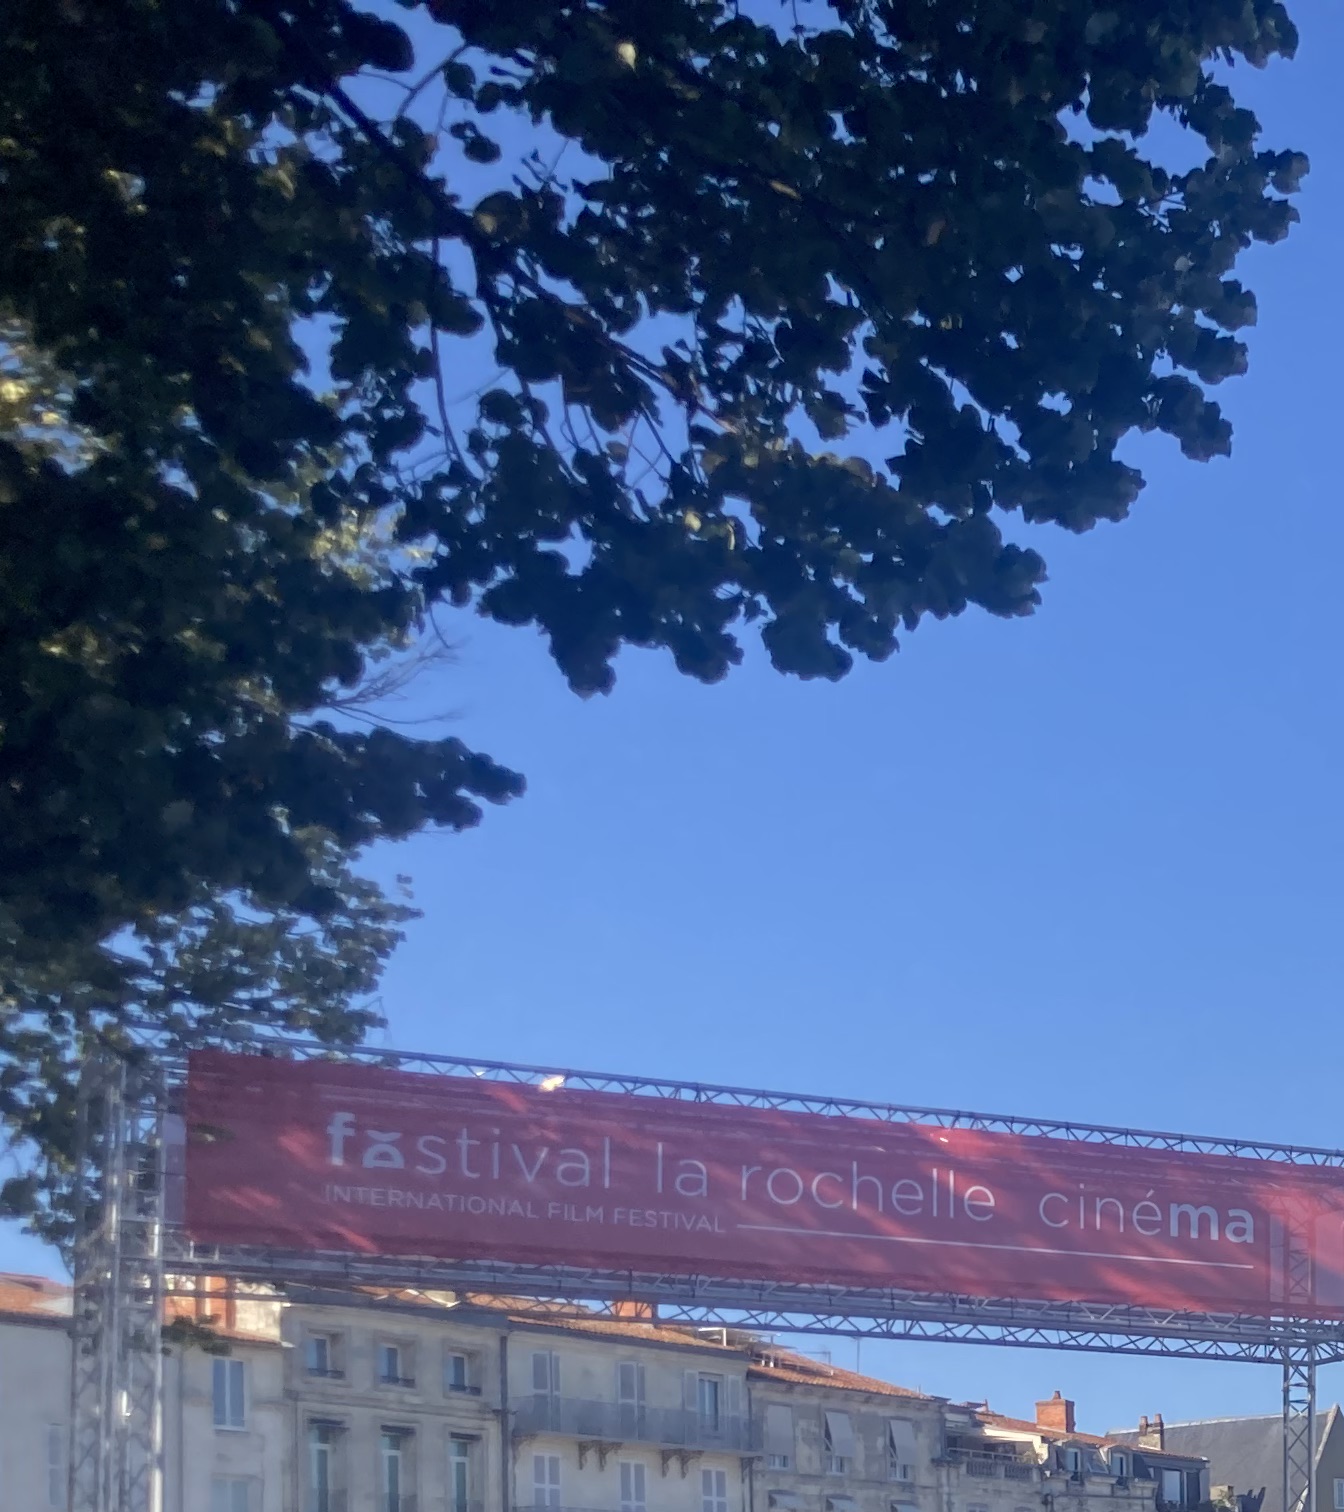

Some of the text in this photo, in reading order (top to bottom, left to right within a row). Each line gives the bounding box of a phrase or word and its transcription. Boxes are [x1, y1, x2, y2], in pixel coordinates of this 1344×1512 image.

[325, 1183, 726, 1233] INTERNATIONAL FILM FESTIVAL
[656, 1141, 708, 1198] la
[740, 1160, 996, 1222] rochelle
[1038, 1183, 1255, 1244] cinéma
